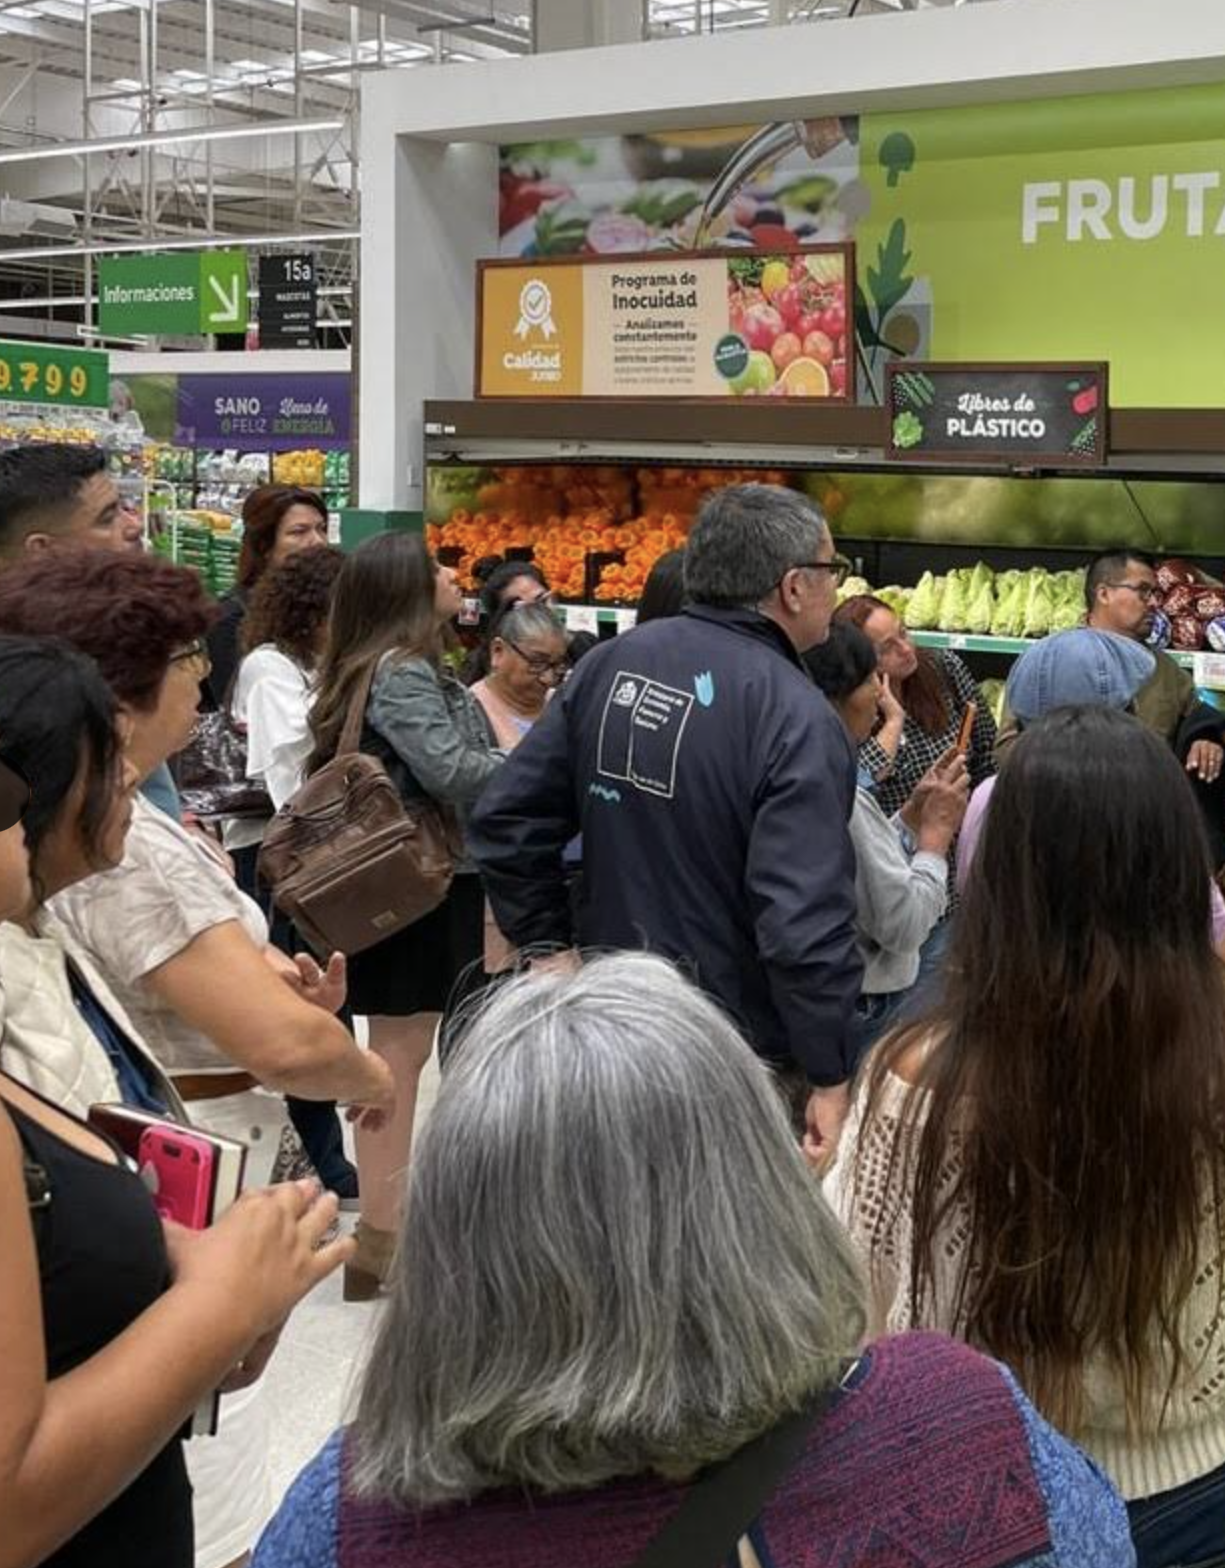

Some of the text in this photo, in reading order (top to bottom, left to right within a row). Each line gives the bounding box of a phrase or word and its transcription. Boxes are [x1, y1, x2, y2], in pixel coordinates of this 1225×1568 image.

[283, 260, 311, 281] 15a
[612, 271, 697, 290] Programa de
[104, 282, 195, 303] Informaciones
[612, 289, 697, 309] Inocuidad
[503, 350, 561, 368] Calidad
[215, 397, 260, 415] SANO
[956, 392, 1036, 415] Libres de
[946, 414, 1046, 437] PLÁSTICO
